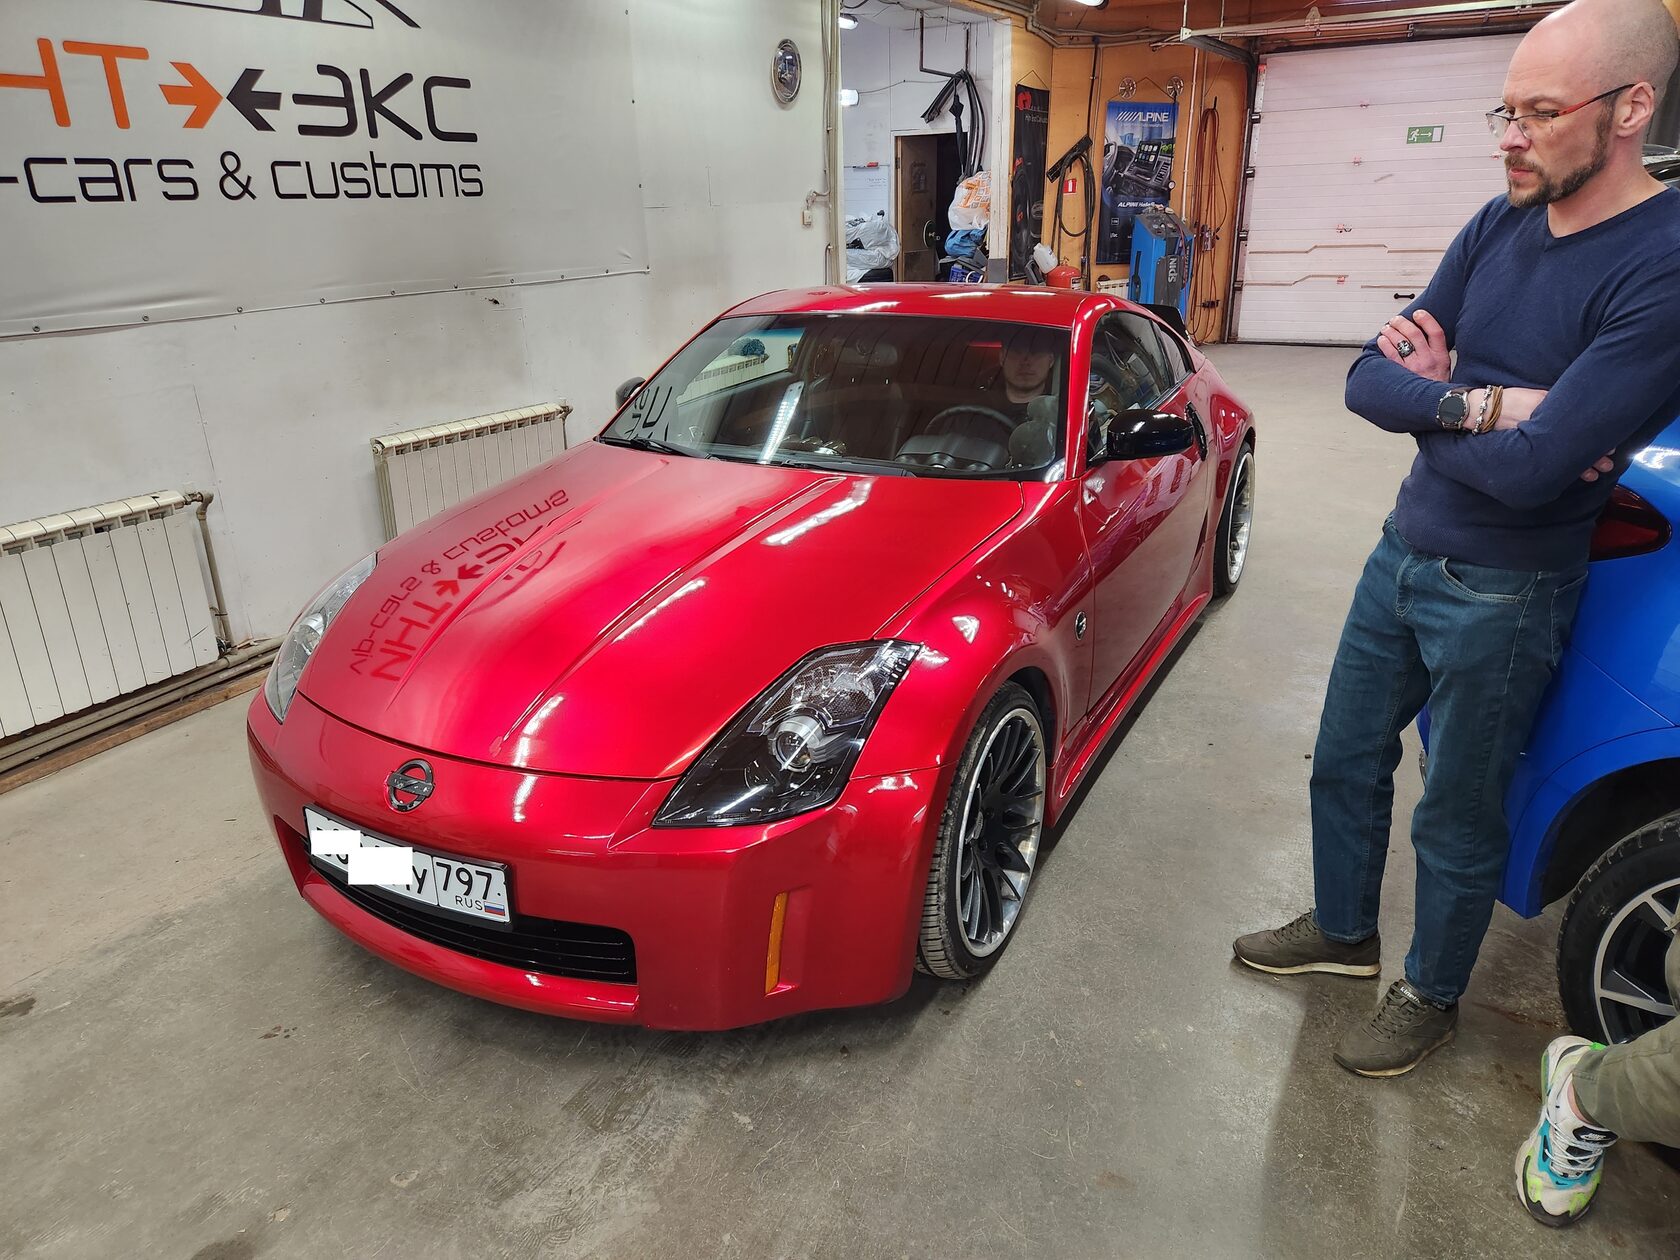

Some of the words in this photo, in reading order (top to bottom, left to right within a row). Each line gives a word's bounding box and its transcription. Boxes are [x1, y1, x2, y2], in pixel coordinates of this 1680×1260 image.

[292, 64, 479, 142] ЭКС
[1116, 111, 1169, 122] ALPINE
[219, 150, 257, 200] &
[271, 151, 485, 199] customs
[436, 861, 492, 900] 797
[455, 895, 483, 911] RUS
